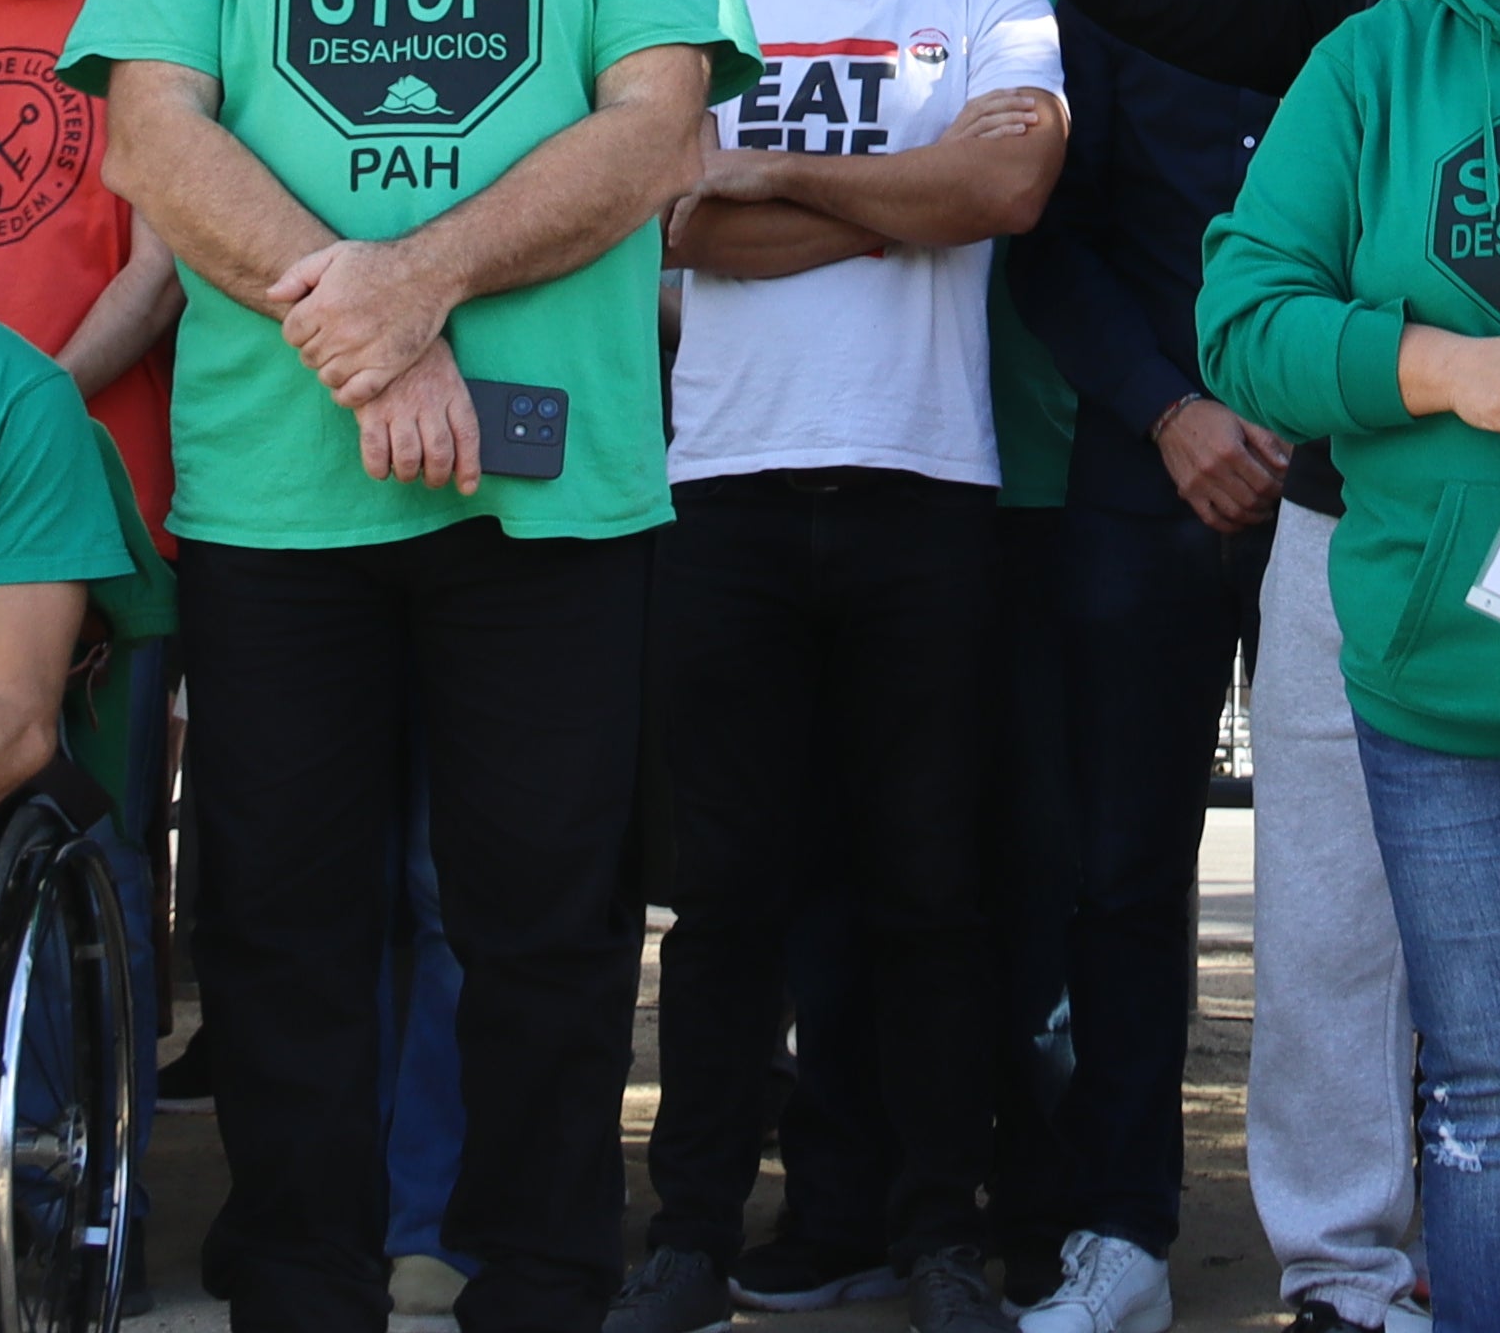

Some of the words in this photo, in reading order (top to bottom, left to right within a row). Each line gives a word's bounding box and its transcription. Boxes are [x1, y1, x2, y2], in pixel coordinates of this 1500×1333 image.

[308, 32, 507, 65] DESAHUCIOS
[738, 61, 896, 124] EAT
[349, 146, 460, 191] PAH
